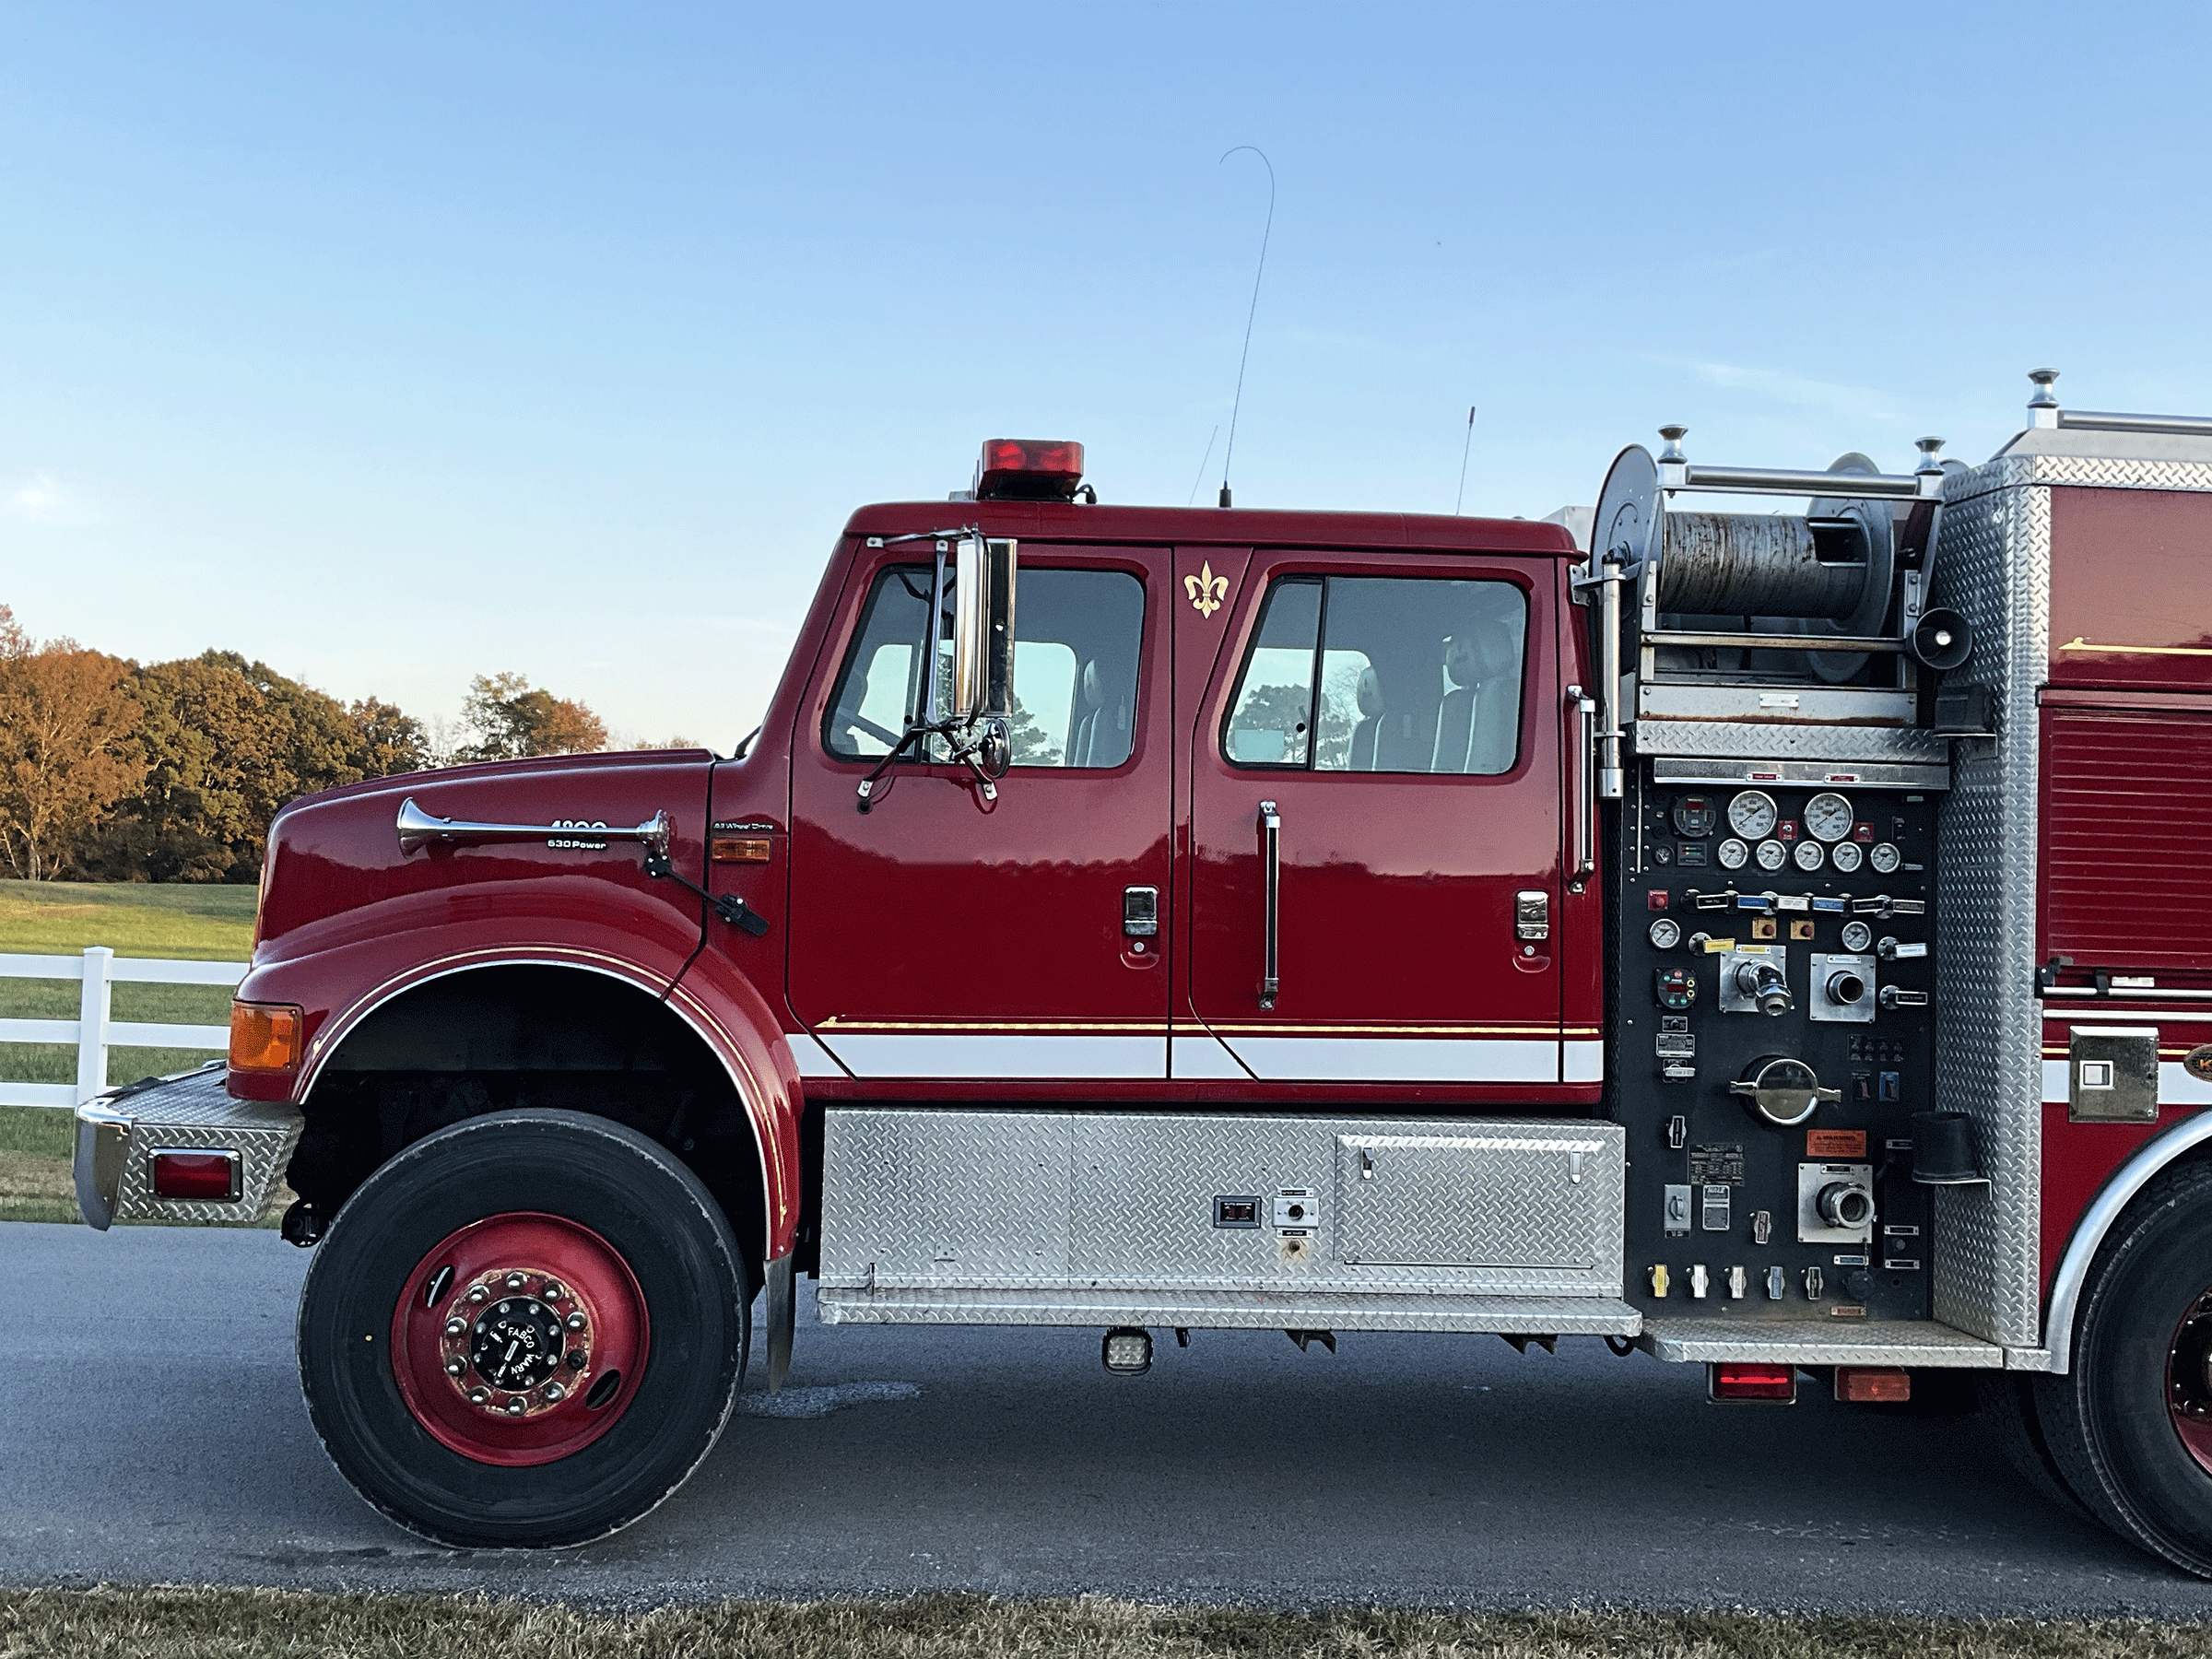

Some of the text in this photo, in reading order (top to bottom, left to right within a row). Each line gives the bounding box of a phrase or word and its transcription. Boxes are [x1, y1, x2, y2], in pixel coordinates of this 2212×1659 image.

[572, 840, 607, 850] Power
[508, 1327, 535, 1348] FABCO
[511, 1354, 535, 1374] WARN
